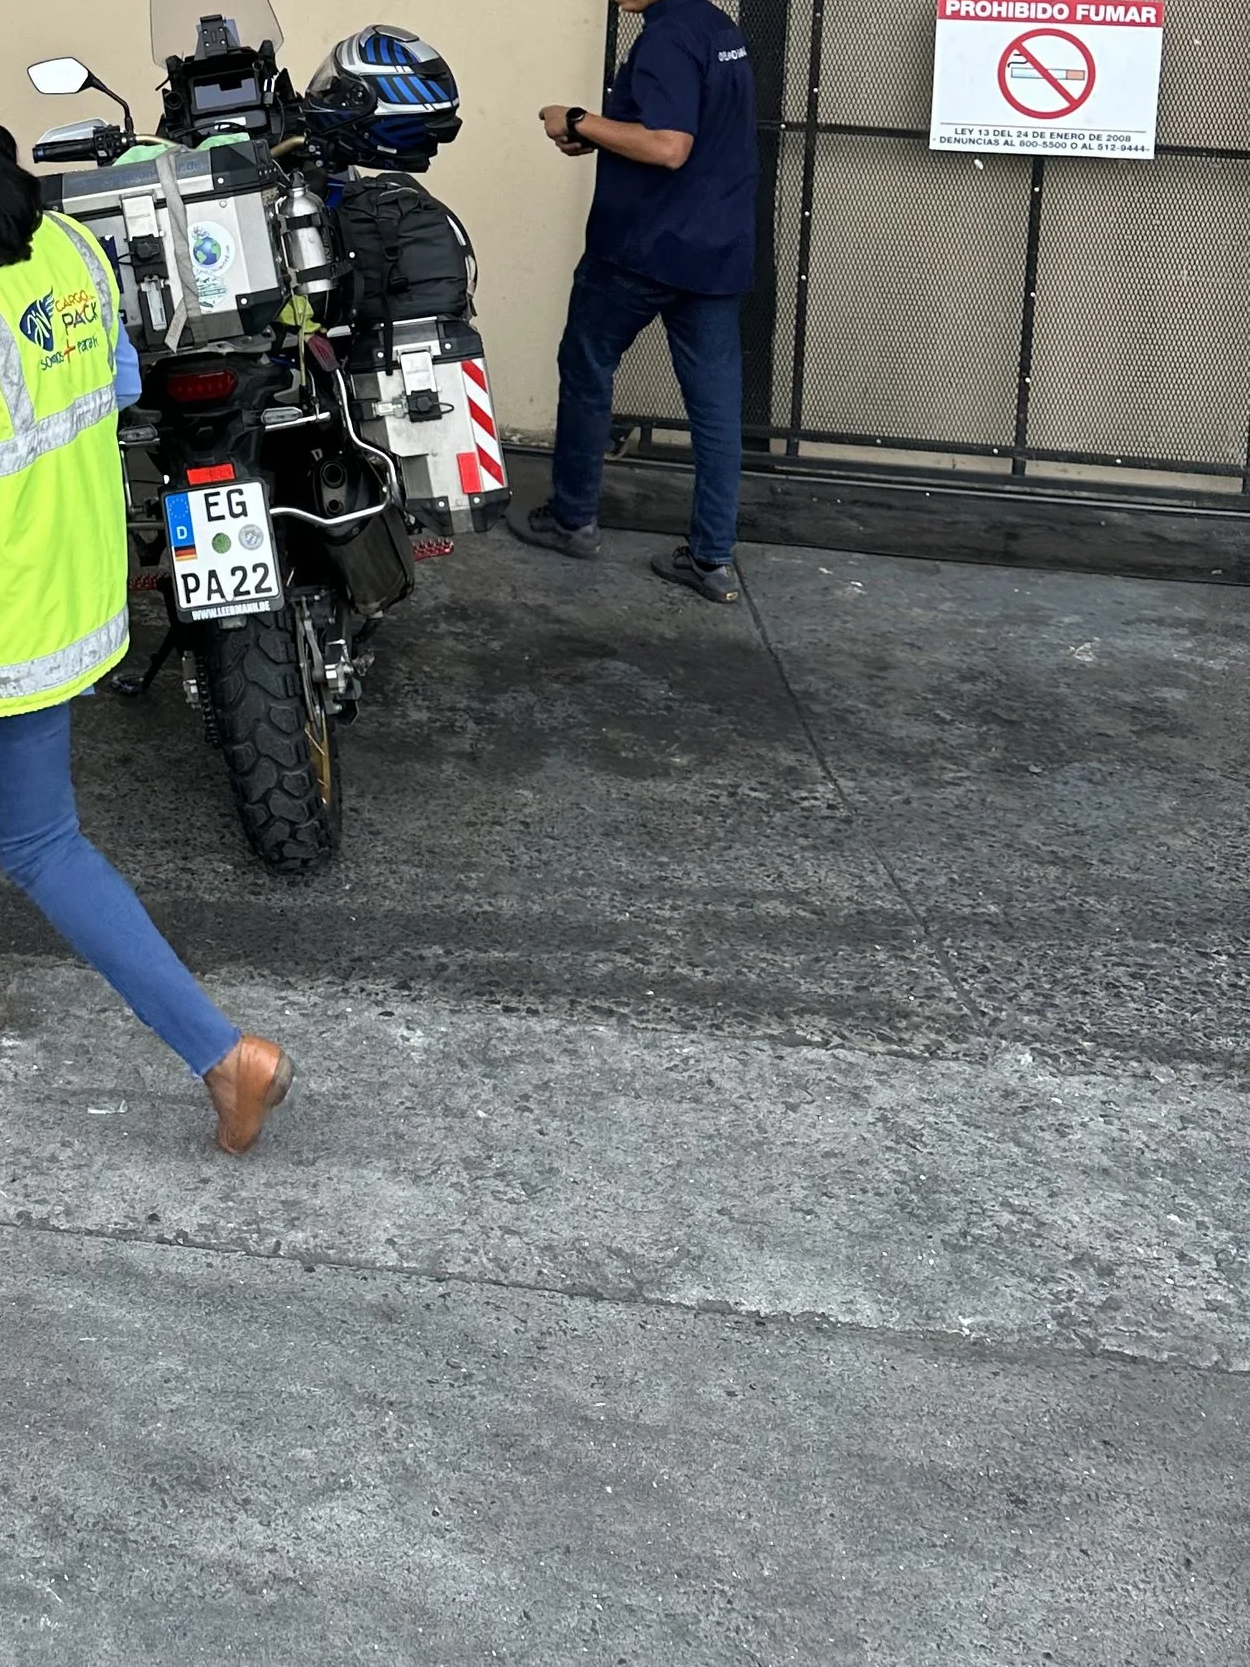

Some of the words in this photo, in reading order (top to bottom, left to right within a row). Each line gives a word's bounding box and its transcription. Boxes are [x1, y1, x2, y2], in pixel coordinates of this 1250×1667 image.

[945, 0, 1070, 21] PROHIBIDO
[1076, 4, 1157, 24] FUMAR
[939, 136, 1000, 146] DENUNCIAS
[1003, 139, 1016, 147] AL
[1081, 142, 1094, 150] AL
[954, 128, 974, 136] LEY
[978, 129, 990, 137] 13
[993, 130, 1013, 138] DEL
[1016, 130, 1029, 138] 24
[1032, 131, 1046, 139] DE
[1049, 132, 1085, 141] ENERO
[1089, 133, 1103, 141] DE
[1106, 134, 1131, 142] 2008
[55, 290, 88, 313] CARGO
[62, 302, 99, 336] PACK
[204, 488, 248, 522] EG
[176, 525, 188, 540] D
